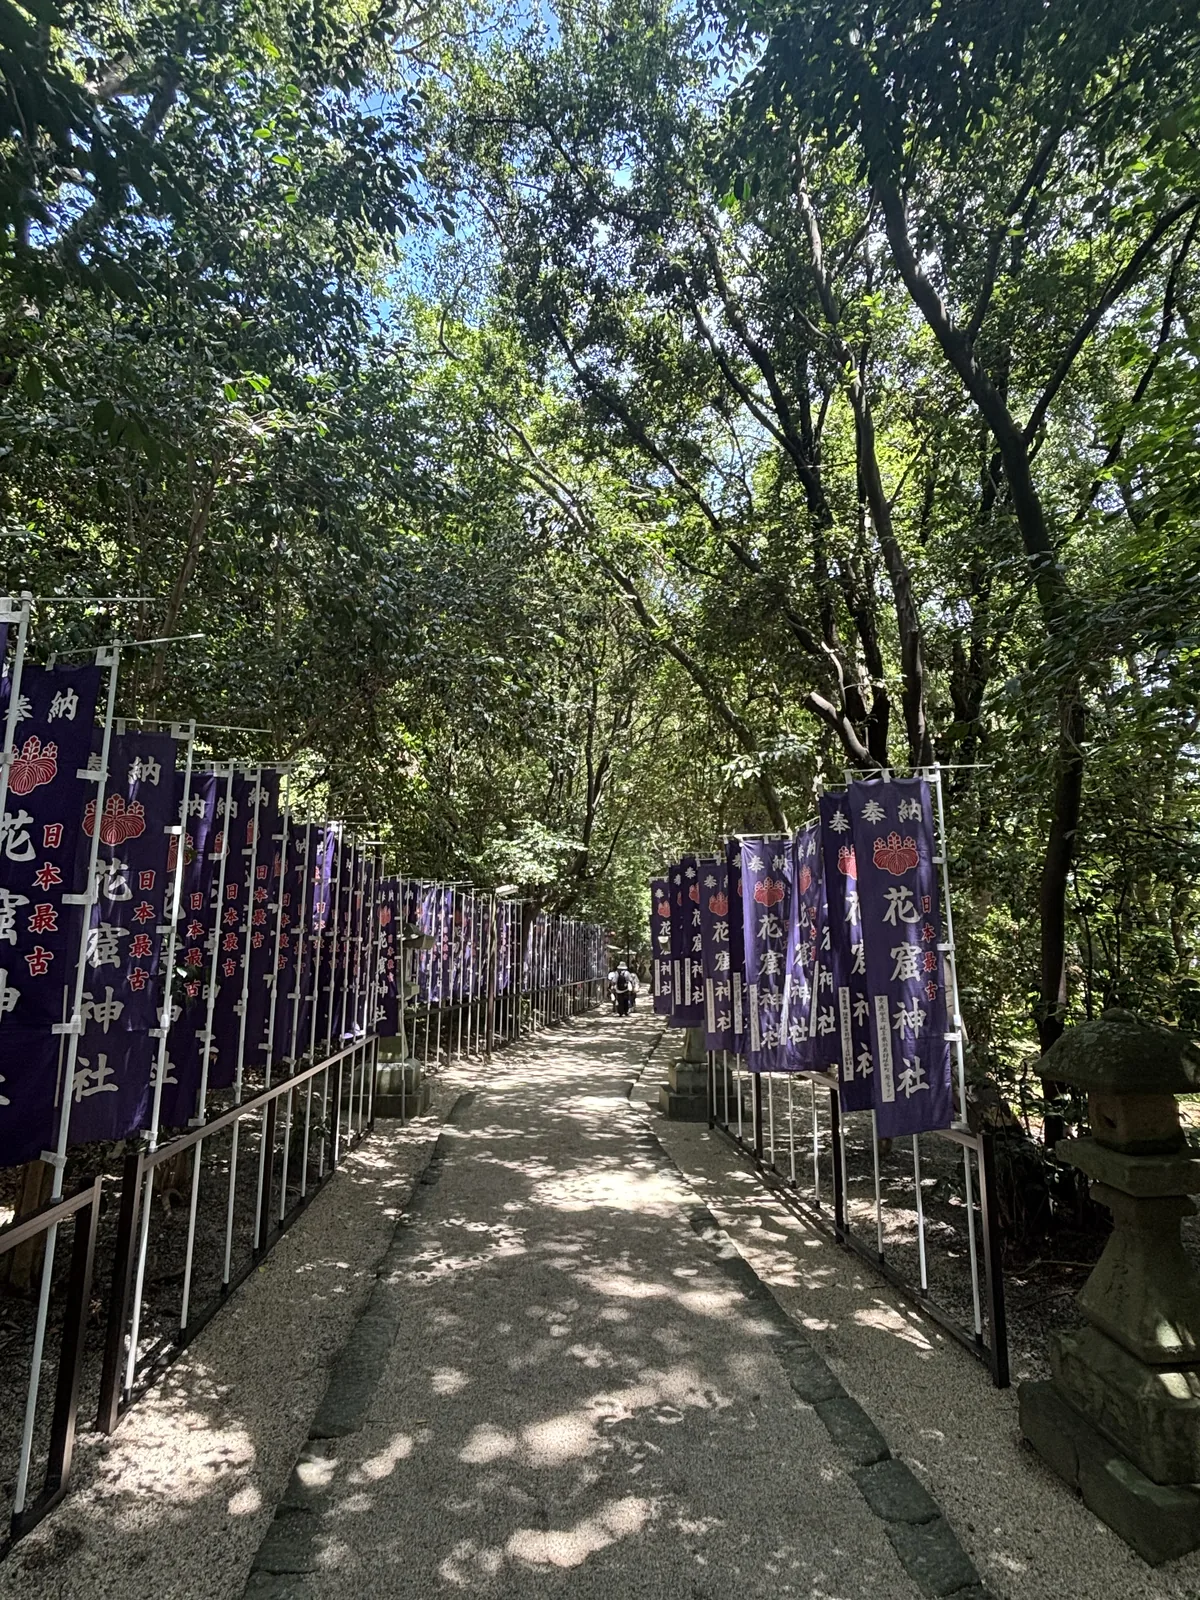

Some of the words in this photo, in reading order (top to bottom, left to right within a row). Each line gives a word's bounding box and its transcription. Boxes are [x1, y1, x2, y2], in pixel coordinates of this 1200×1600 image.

[748, 854, 790, 872] 奉納
[829, 810, 851, 835] 奉
[861, 798, 922, 825] 奉納
[25, 822, 64, 978] 日本最古
[127, 869, 156, 993] 日本最古
[183, 892, 205, 998] 日本最古
[221, 882, 239, 977] 日本最古
[252, 864, 269, 949] 日本最古
[920, 894, 938, 1002] 日本最古
[71, 857, 133, 1103] 花窟神社
[660, 920, 672, 996] 花神社
[757, 914, 784, 1051] 花窟神社
[882, 885, 930, 1100] 花窟神社
